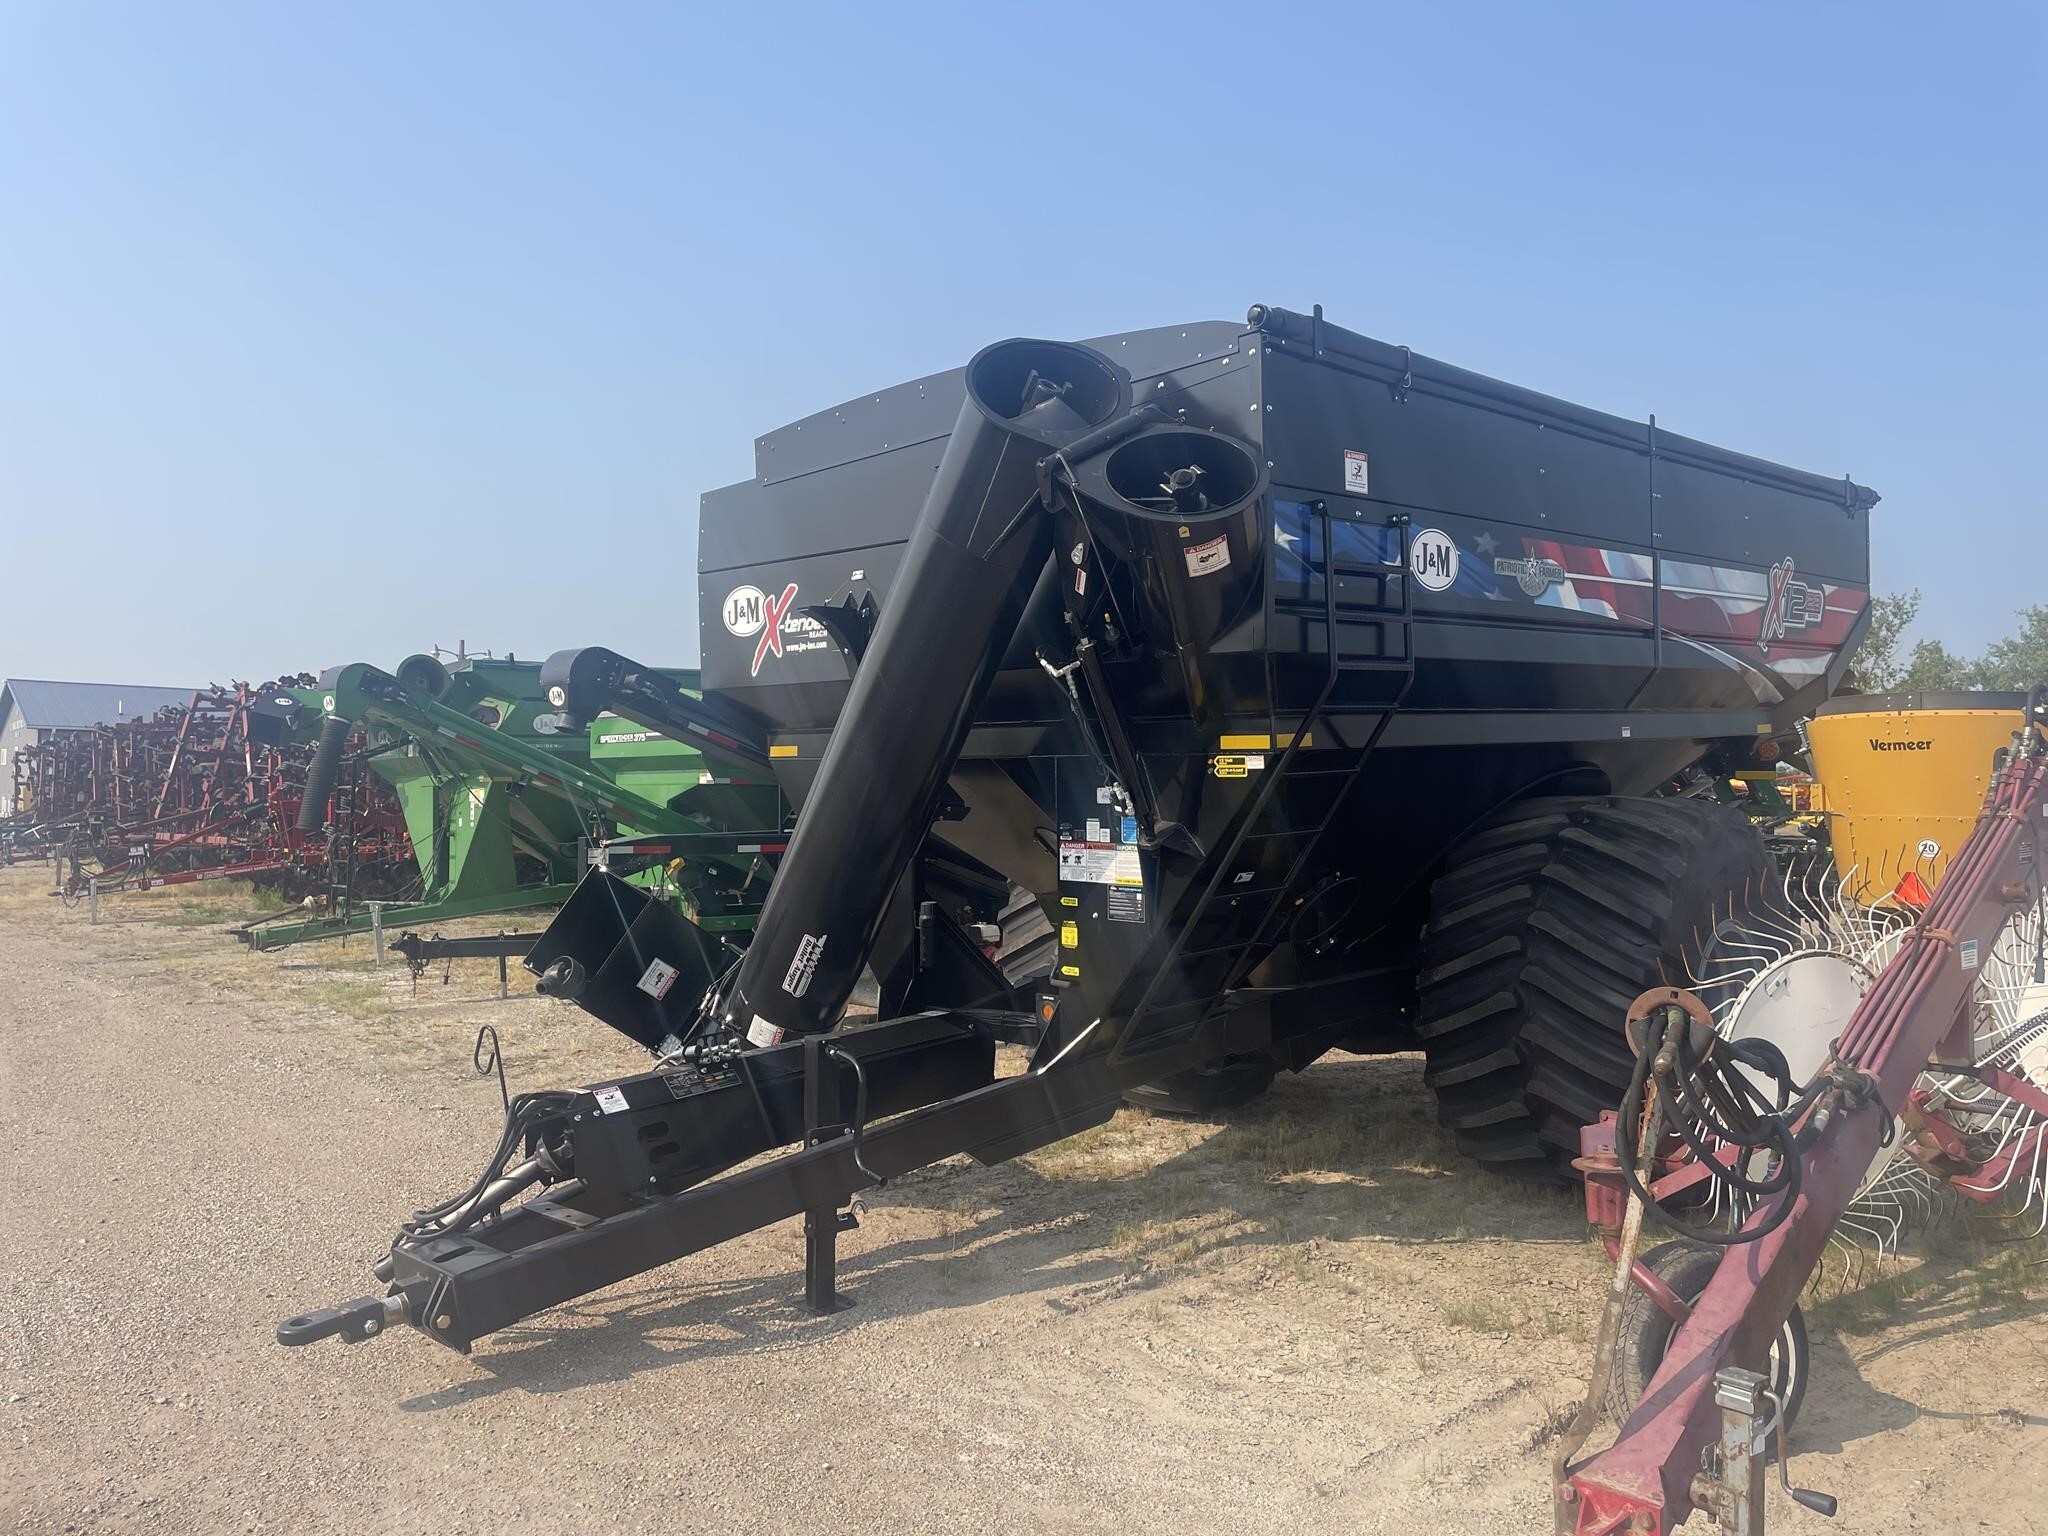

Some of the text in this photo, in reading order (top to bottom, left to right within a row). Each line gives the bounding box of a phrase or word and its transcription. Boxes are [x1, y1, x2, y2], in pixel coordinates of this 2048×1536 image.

[1415, 542, 1451, 578] J&M
[728, 596, 760, 626] J&M
[633, 732, 646, 742] 375
[1868, 738, 1932, 752] Vermeer
[1920, 843, 1935, 853] 20
[787, 938, 813, 989] Bullet Auger
